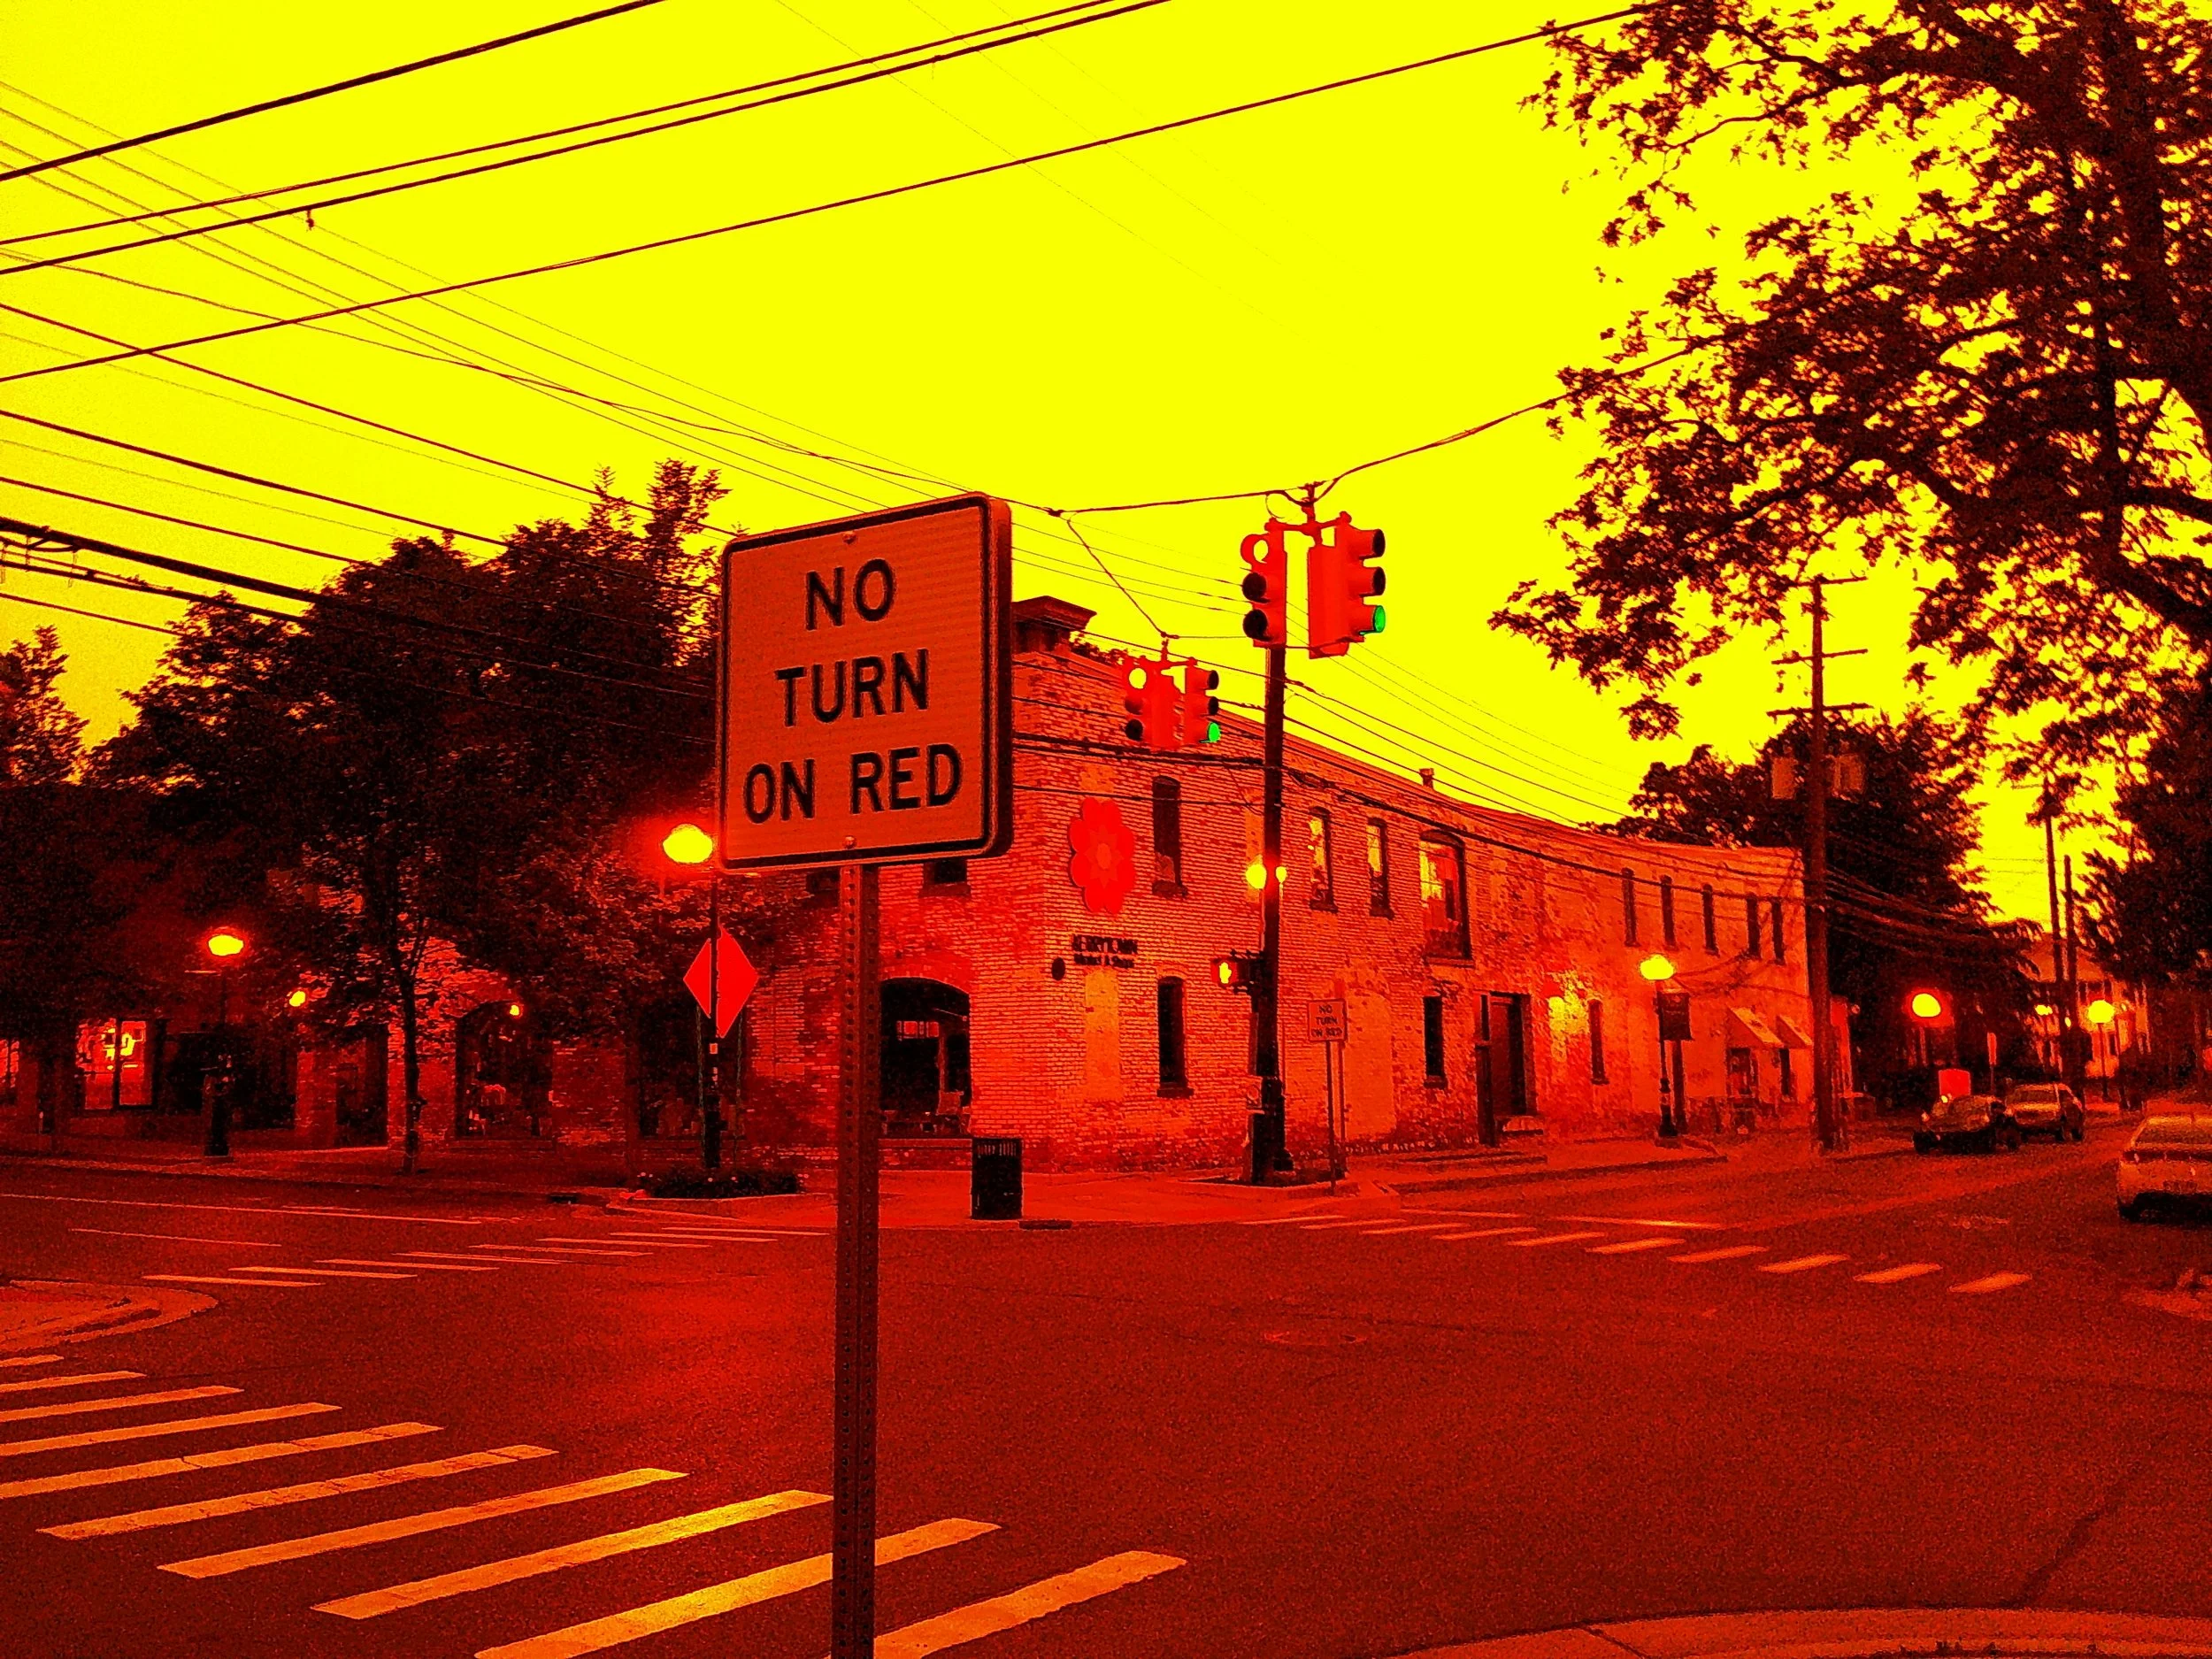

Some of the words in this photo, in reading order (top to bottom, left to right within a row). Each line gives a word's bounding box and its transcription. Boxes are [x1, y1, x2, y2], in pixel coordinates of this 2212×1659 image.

[805, 558, 895, 631] NO
[775, 649, 929, 726] TURN
[743, 758, 816, 824] ON
[850, 743, 962, 814] RED
[1316, 1016, 1338, 1025] TURN
[1318, 1004, 1333, 1014] NO
[1311, 1028, 1323, 1037] ON
[1325, 1027, 1342, 1036] RED
